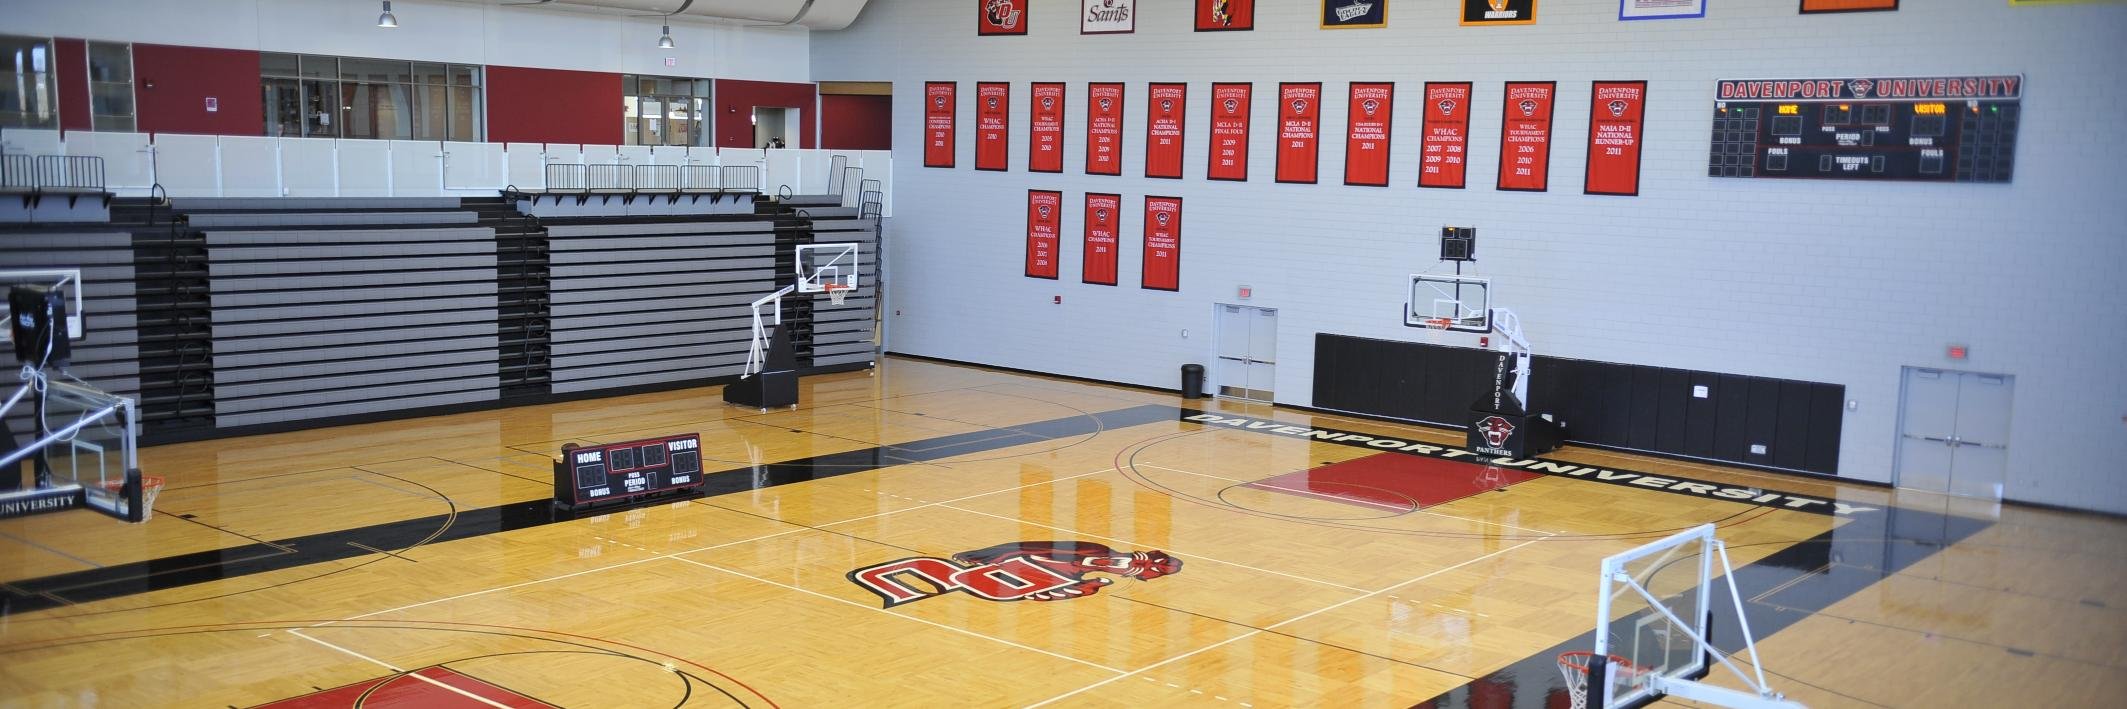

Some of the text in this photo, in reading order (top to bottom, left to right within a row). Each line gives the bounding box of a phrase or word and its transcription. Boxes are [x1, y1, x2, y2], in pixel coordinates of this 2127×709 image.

[1088, 3, 1129, 23] Saints
[1721, 77, 2017, 98] DAVENPORT UNIVERSITY
[1914, 103, 1946, 114] VISITOR
[1835, 133, 1860, 141] PERIOD
[1446, 145, 1461, 153] 2008
[1518, 145, 1534, 153] 2006
[1921, 149, 1944, 157] FOULS
[1445, 156, 1460, 164] 2010
[1494, 355, 1505, 410] DAVENPORT
[668, 439, 698, 452] VISITOR
[1476, 446, 1512, 457] PANTHERS
[577, 451, 601, 464] HOME
[1185, 413, 1880, 516] DAVENPORT UNIVERSITY
[624, 477, 646, 487] PERIOD
[671, 475, 690, 485] BONUS
[590, 487, 610, 498] BONUS
